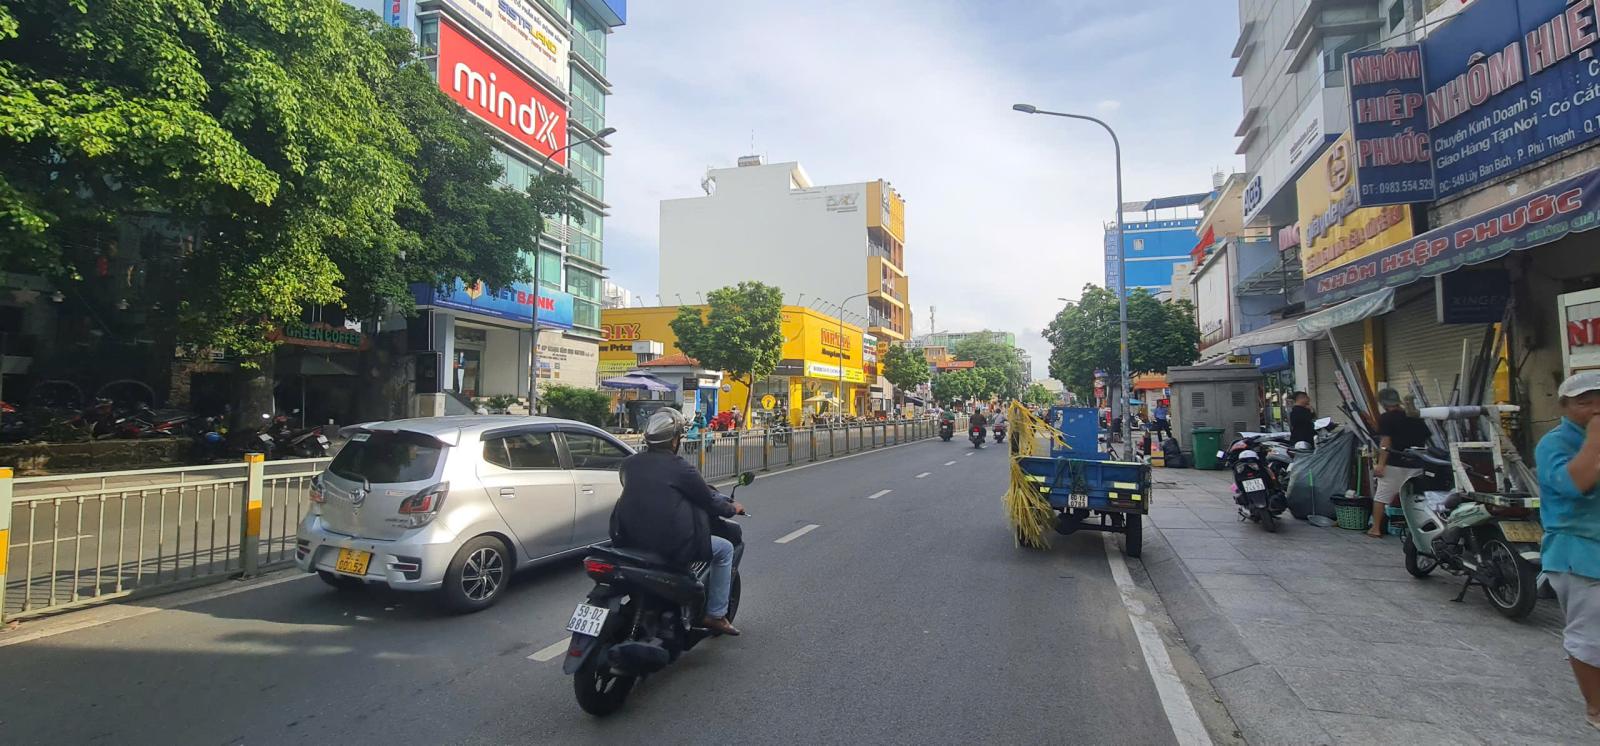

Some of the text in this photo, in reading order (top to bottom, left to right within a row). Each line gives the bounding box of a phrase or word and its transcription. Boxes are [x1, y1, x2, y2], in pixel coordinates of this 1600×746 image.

[1351, 47, 1421, 85] NHÔM
[1425, 0, 1600, 129] NHÔM HIỆ
[453, 62, 559, 150] mindX
[1356, 88, 1423, 125] HIỆP
[1435, 128, 1467, 152] Chuyên
[1468, 116, 1491, 135] Kinh
[1493, 98, 1528, 124] Doanh
[1357, 127, 1431, 168] PHƯỚC
[1436, 152, 1460, 169] Giao
[1461, 136, 1490, 159] Hàng
[1318, 261, 1377, 293] NHÔM
[1381, 238, 1449, 270] HIỆP
[1454, 187, 1583, 249] PHƯỚC
[485, 281, 555, 311] VETBANK
[325, 328, 361, 347] COFFEE
